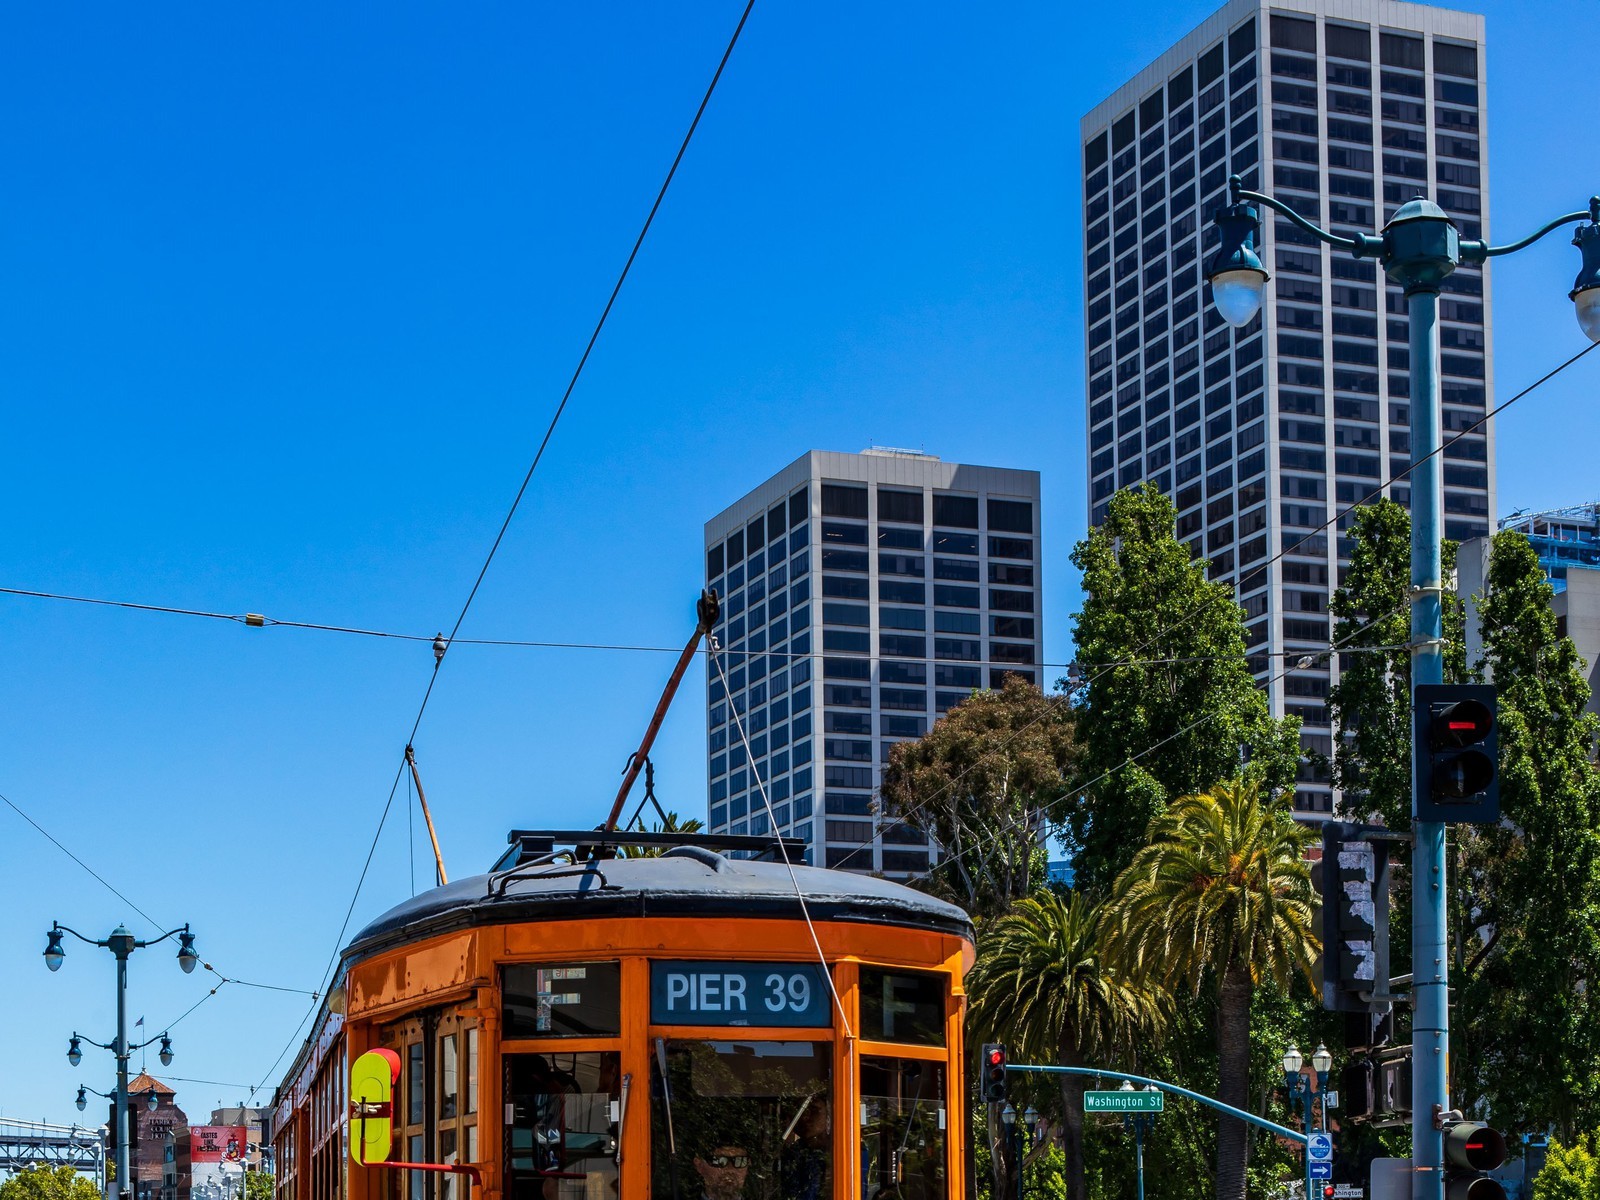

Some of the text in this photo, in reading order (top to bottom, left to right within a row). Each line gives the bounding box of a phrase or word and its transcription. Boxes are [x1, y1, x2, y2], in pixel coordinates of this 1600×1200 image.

[537, 968, 586, 1031] F
[666, 973, 811, 1012] PIER 39
[883, 975, 918, 1037] F
[1087, 1096, 1161, 1109] Washington St
